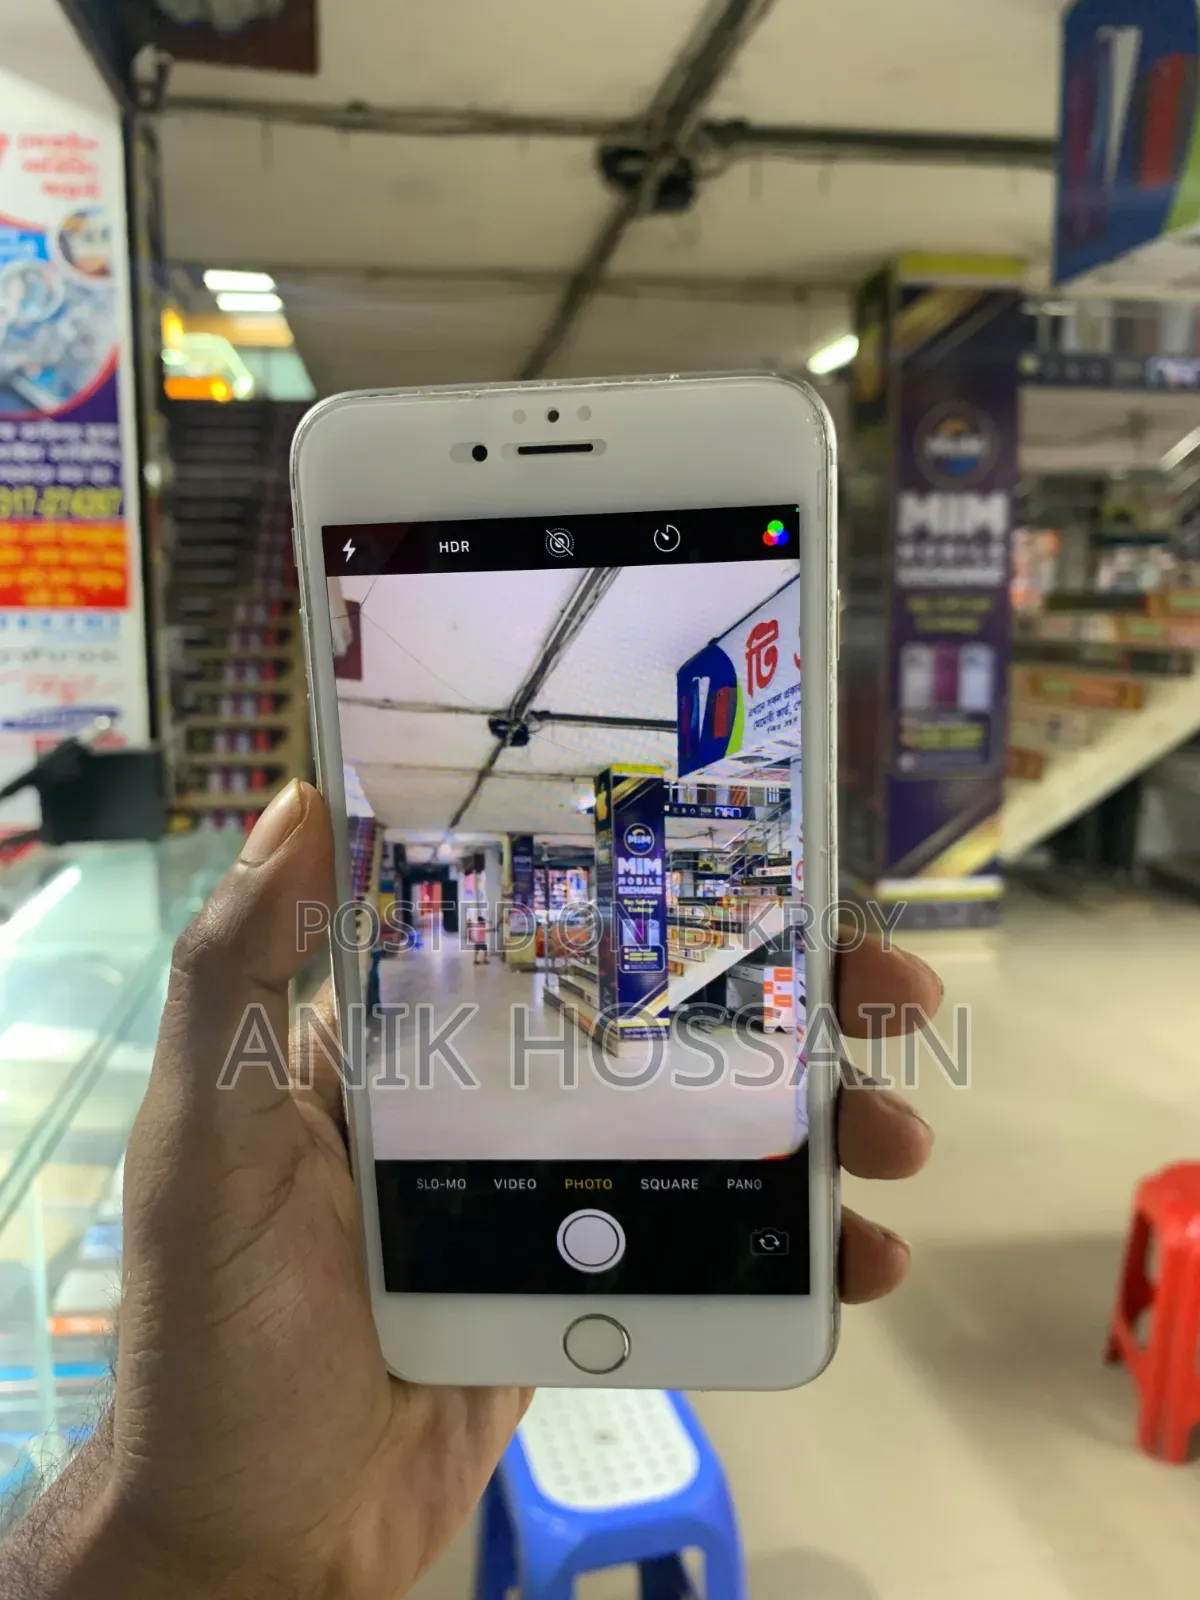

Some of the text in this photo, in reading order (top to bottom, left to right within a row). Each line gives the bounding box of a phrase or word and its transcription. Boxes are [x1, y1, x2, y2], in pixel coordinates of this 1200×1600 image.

[439, 540, 470, 553] HDR
[618, 857, 662, 875] MIM
[618, 877, 662, 886] MOBILE
[618, 886, 662, 895] EXCHANGE
[416, 1177, 763, 1191] SLO-MO VIDEO PHOTO SQUARE PANO
